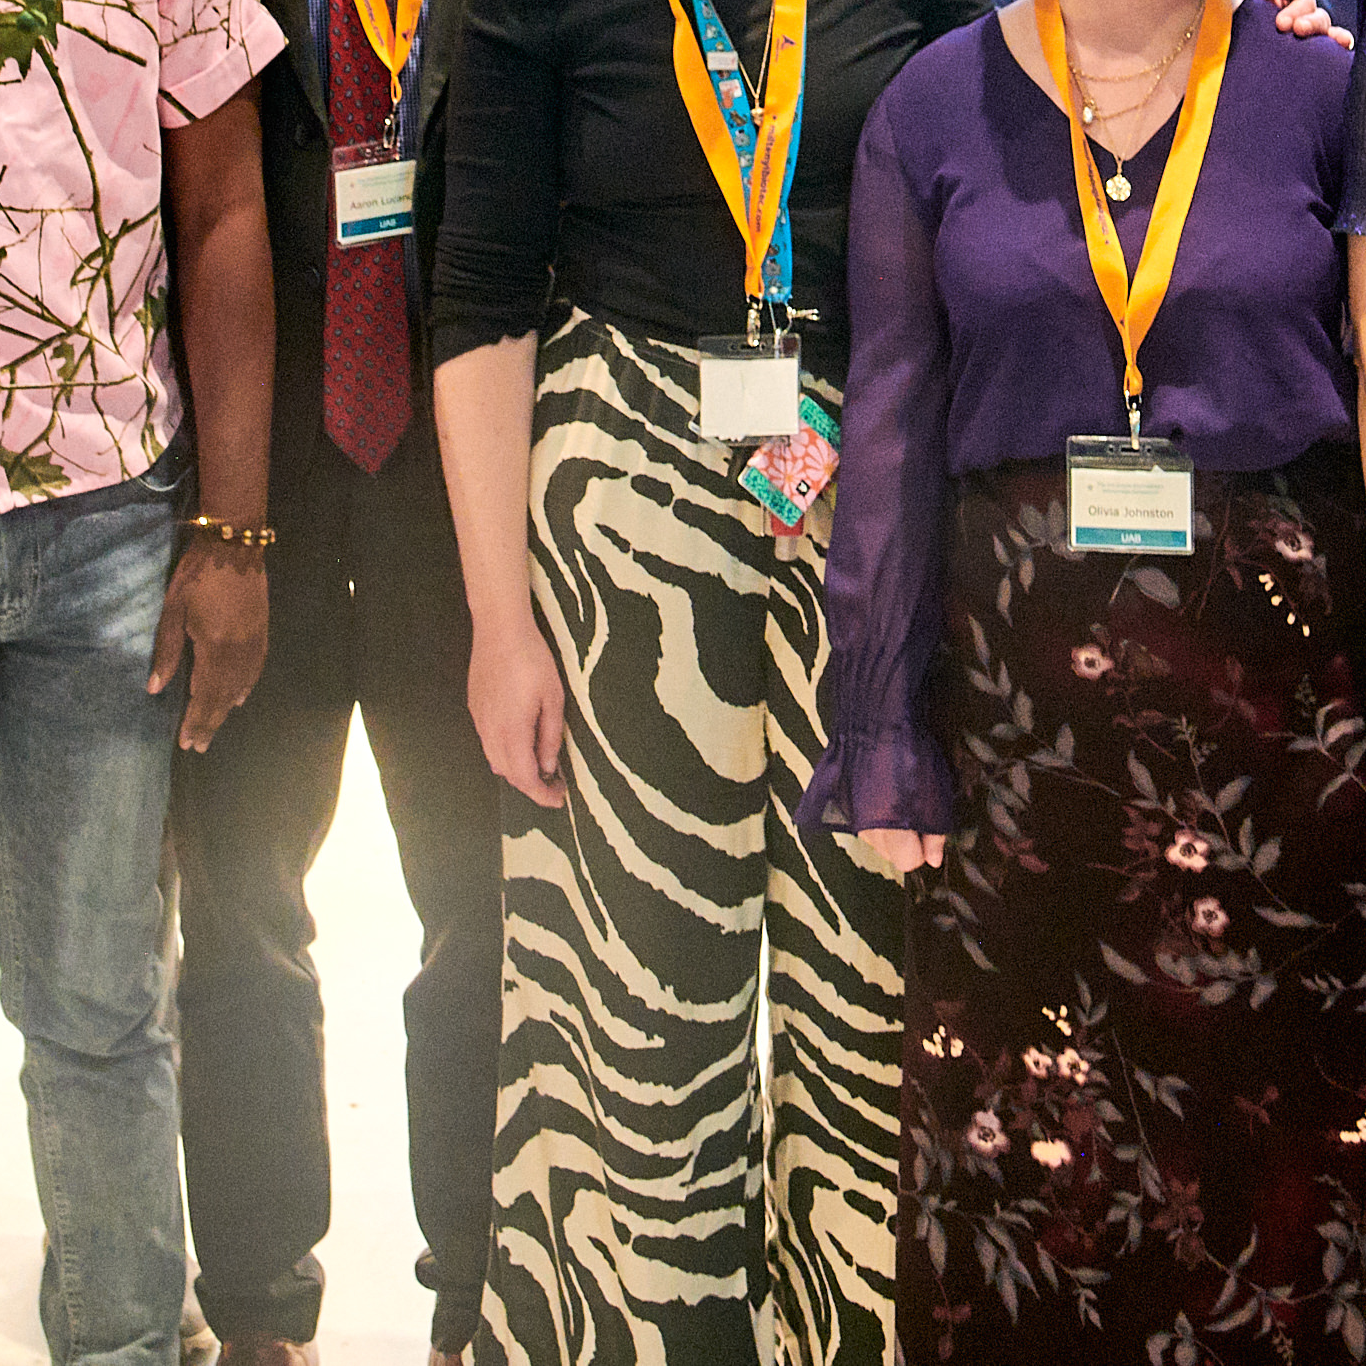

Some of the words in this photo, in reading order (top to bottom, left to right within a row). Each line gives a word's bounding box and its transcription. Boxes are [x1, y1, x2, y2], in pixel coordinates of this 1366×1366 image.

[350, 199, 378, 210] Aaron
[379, 218, 397, 228] UAB
[1088, 505, 1120, 517] Olivia
[1124, 507, 1175, 519] Johnston
[1120, 533, 1142, 543] UAB
